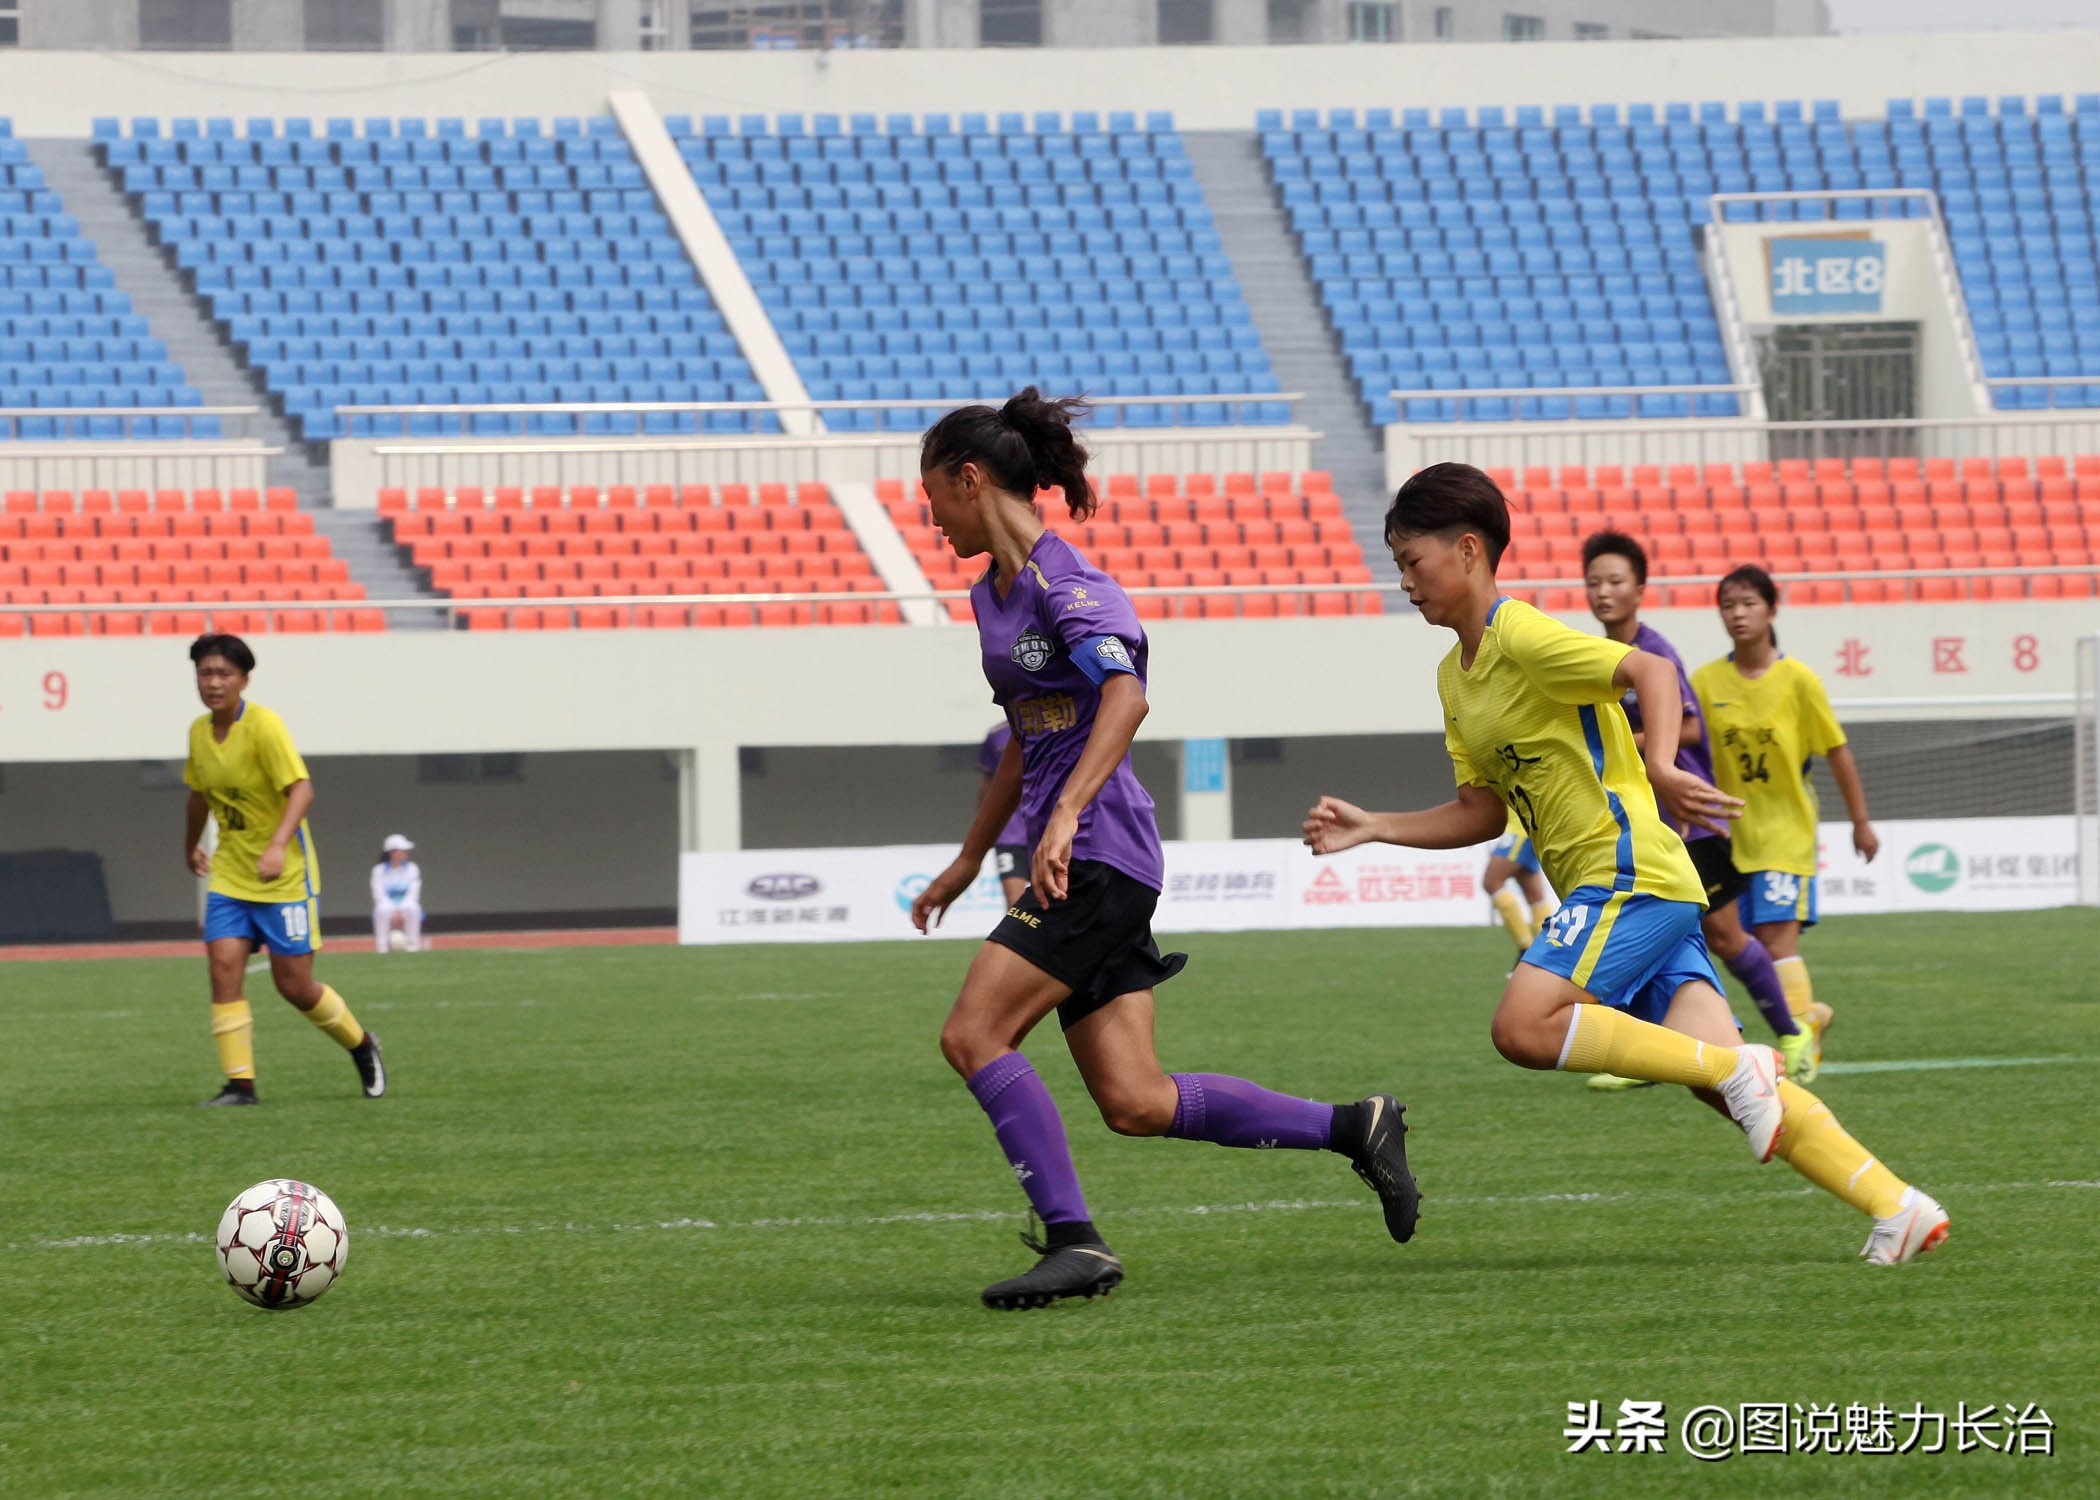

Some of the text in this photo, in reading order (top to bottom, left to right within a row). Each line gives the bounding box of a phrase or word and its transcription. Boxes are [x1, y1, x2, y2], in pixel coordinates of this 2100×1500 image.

[1773, 256, 1882, 296] 北区8
[1066, 600, 1101, 612] KELME
[42, 669, 69, 712] 9
[1739, 752, 1770, 784] 34
[1764, 871, 1799, 902] 34
